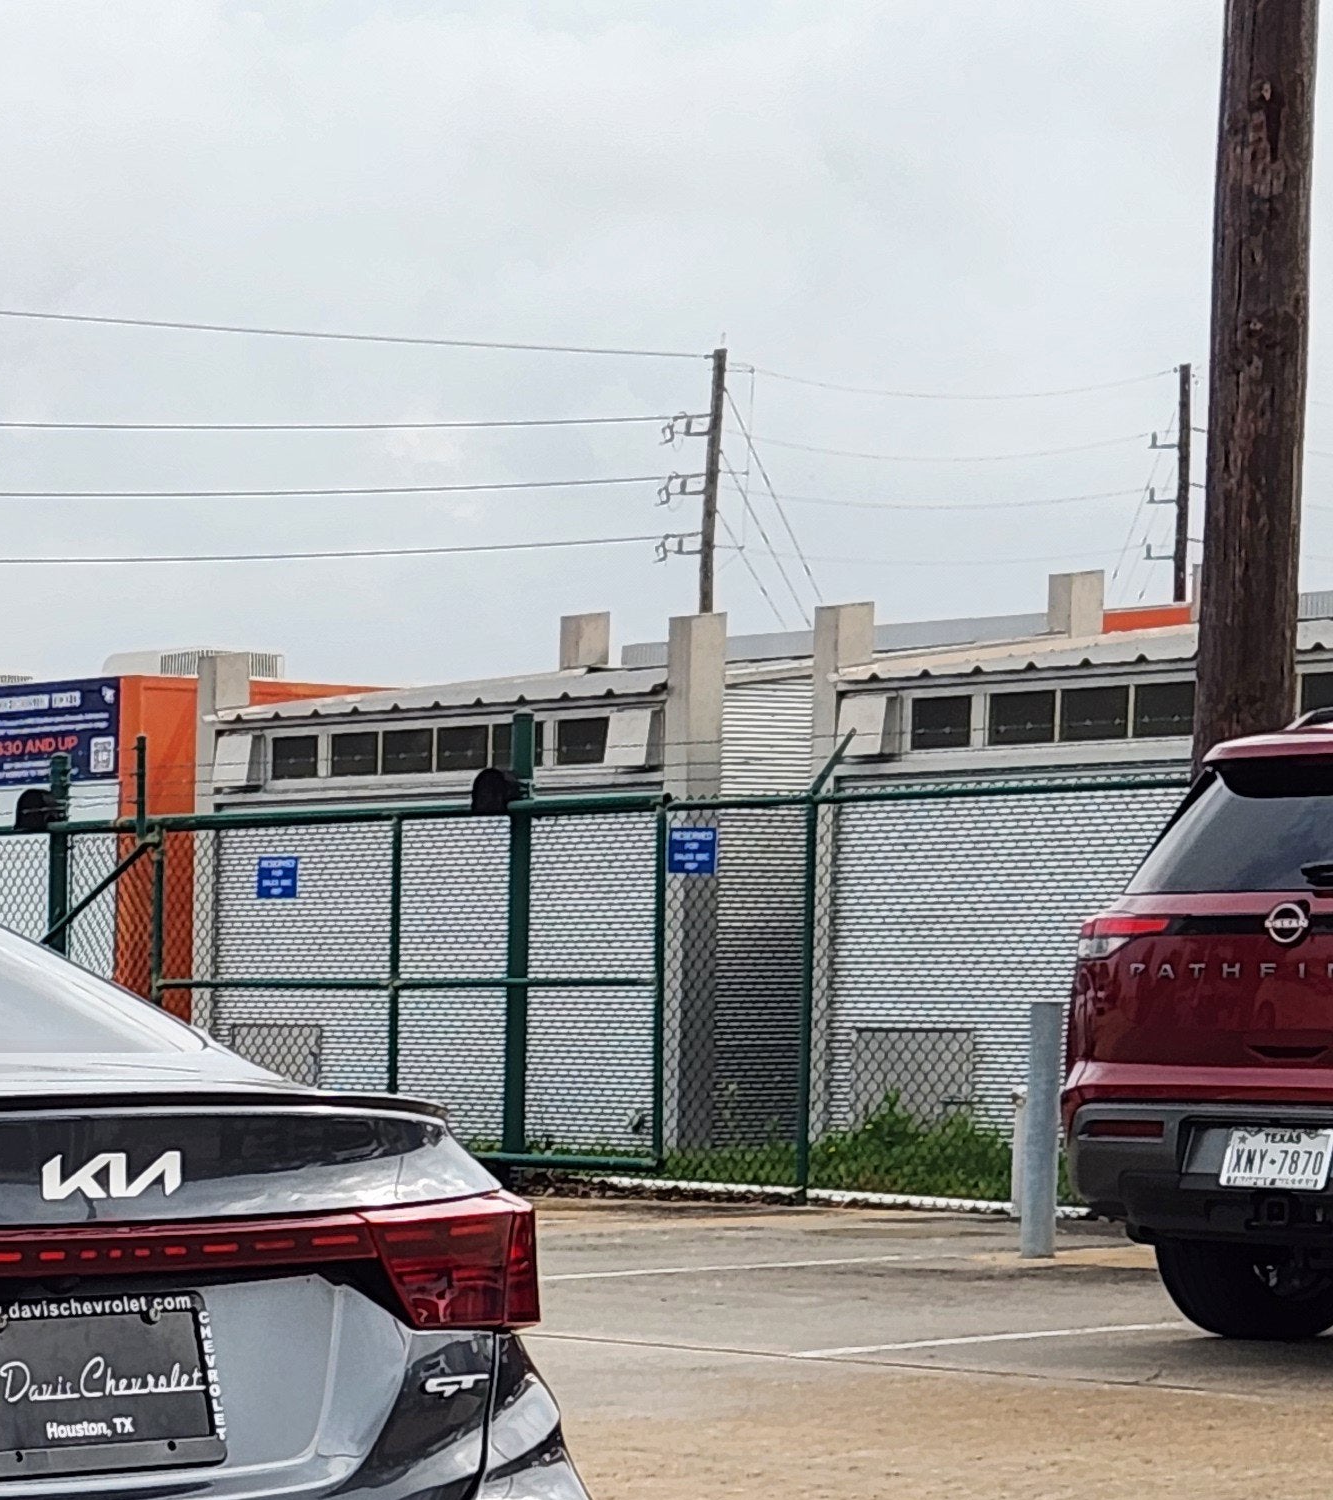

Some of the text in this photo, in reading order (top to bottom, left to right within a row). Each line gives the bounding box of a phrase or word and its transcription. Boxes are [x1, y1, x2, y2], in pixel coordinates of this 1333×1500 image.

[25, 738, 56, 754] AND
[58, 735, 79, 751] UP
[1264, 1131, 1302, 1144] TEXAS
[41, 1150, 182, 1200] KIA
[0, 1356, 207, 1403] Davis Chevrolet
[46, 1416, 135, 1440] Houston, TX
